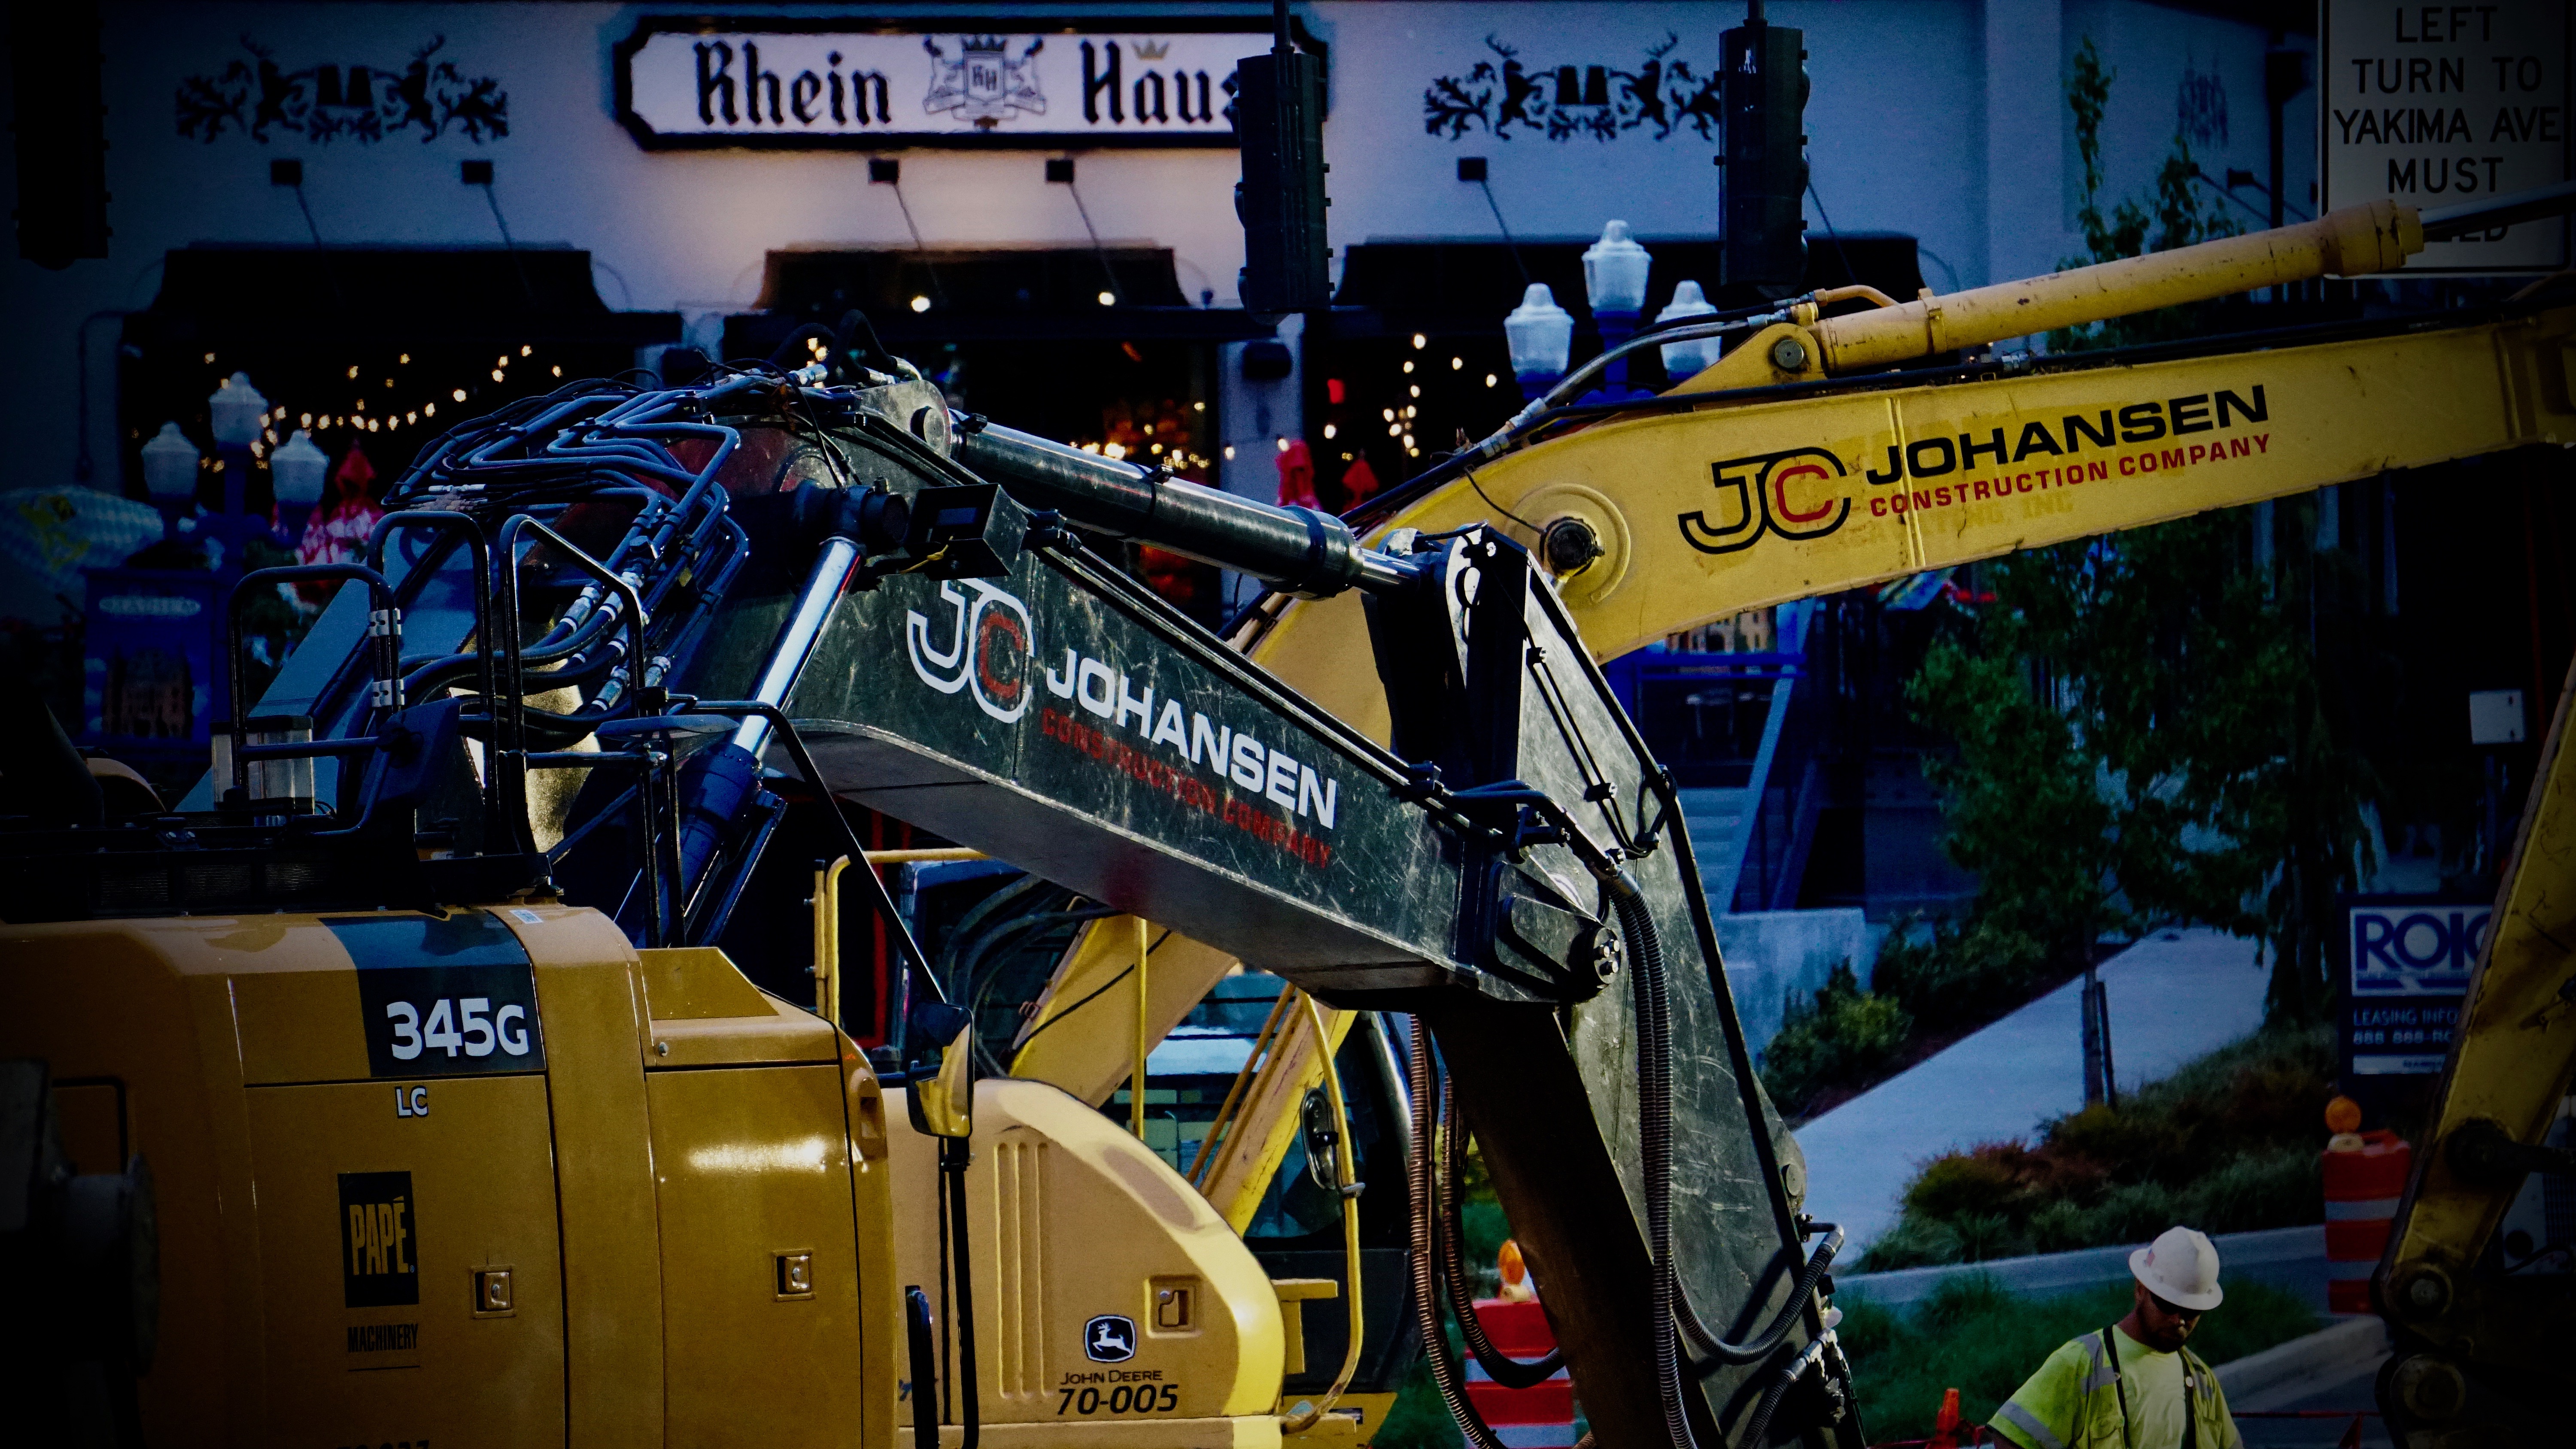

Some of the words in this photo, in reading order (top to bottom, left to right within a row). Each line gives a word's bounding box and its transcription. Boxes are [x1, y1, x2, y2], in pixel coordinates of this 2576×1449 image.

[2396, 6, 2497, 42] LEFT
[693, 39, 892, 126] Rhein
[2351, 58, 2464, 94] TURN
[2492, 56, 2542, 92] TO
[2333, 108, 2472, 144] YAKIMA
[2490, 106, 2561, 142] AVE
[2388, 157, 2504, 193] MUST
[1866, 385, 2269, 486] JOHANSEN
[1870, 460, 2109, 517] CONSTRUCTION
[2119, 434, 2270, 477] COMPANY
[1047, 649, 1337, 830] JOHANSEN
[1042, 708, 1218, 815] CONSTRUCTION
[1222, 797, 1332, 869] COMPANY
[386, 998, 529, 1060] 345G
[2353, 1007, 2417, 1026] LEASING
[396, 1087, 428, 1118] LC
[349, 1196, 410, 1276] PAPÉ
[348, 1324, 418, 1353] MACHINERY
[1060, 1372, 1105, 1385] JOHN
[1109, 1370, 1163, 1383] DEERE
[1058, 1384, 1179, 1416] 70-005
